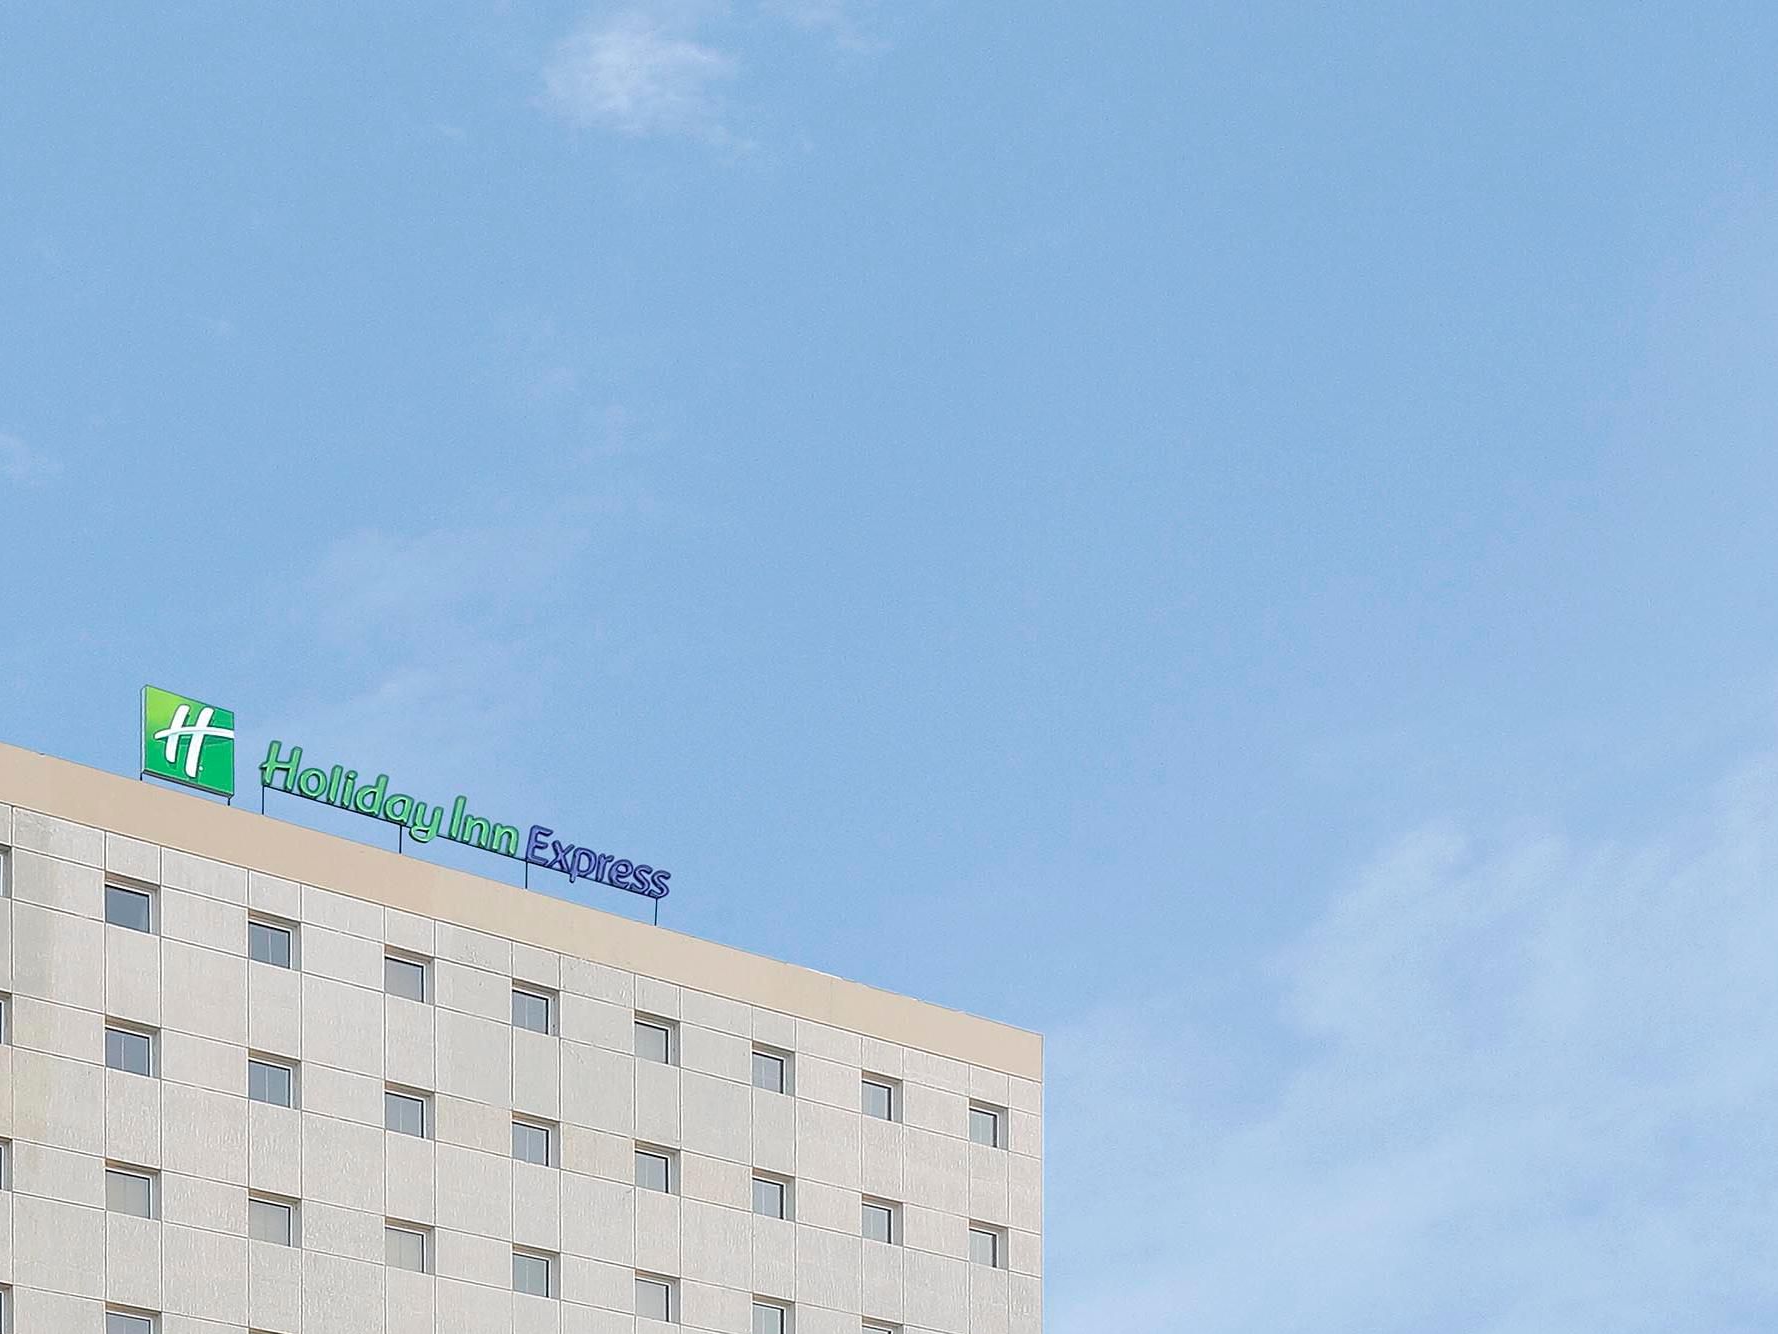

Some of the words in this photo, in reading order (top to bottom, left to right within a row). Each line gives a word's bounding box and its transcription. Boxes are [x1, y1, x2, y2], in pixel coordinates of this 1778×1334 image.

[153, 704, 234, 778] H
[259, 740, 443, 842] Holiday
[450, 796, 520, 857] Inn
[525, 824, 671, 899] Express
